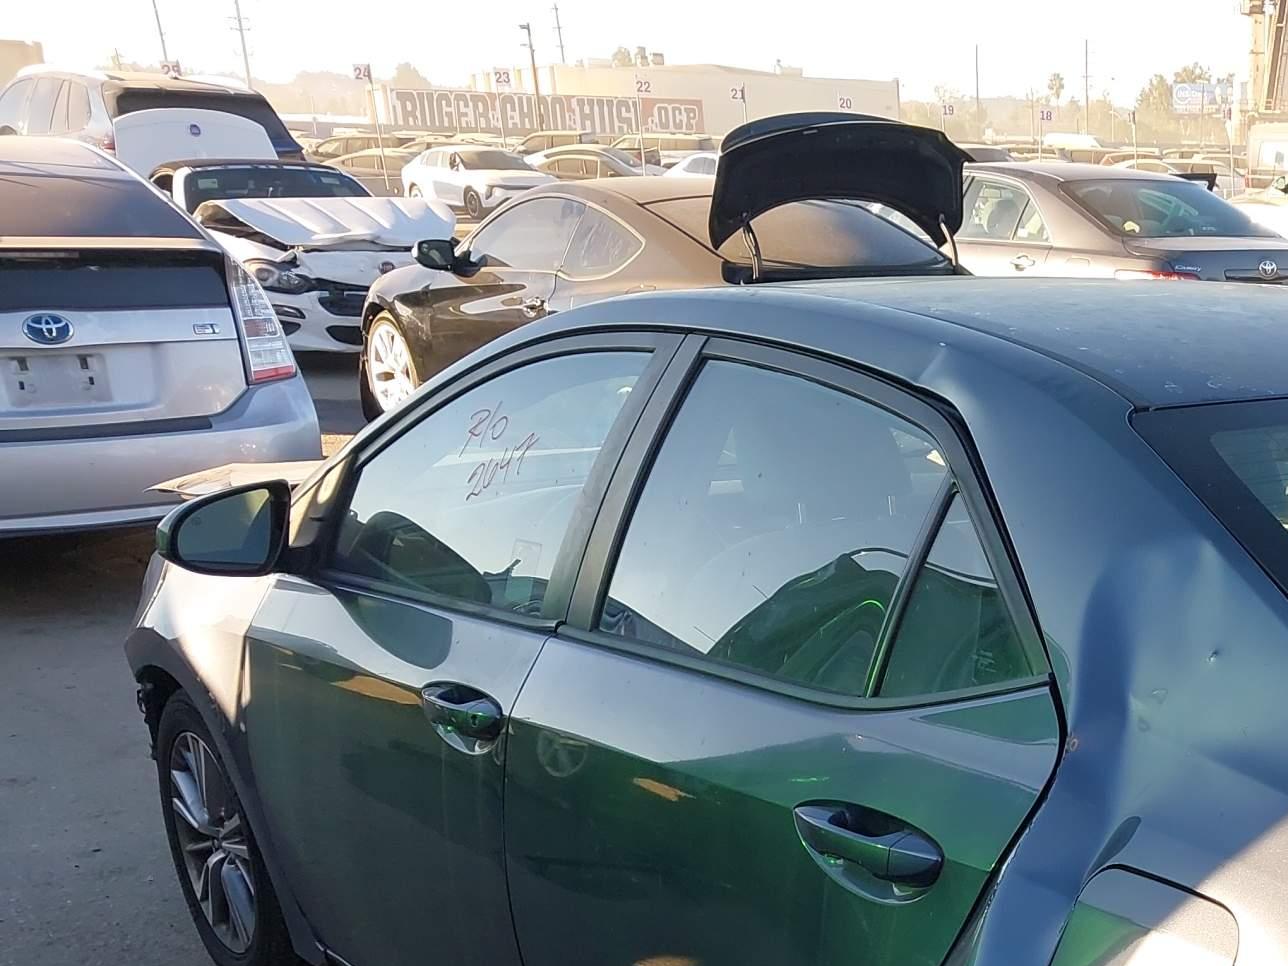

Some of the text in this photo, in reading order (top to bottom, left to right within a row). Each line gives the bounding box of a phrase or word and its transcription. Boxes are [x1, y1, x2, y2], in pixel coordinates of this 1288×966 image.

[354, 67, 371, 80] 24
[495, 71, 511, 84] 23
[636, 81, 651, 93] 22
[731, 88, 745, 100] 21
[839, 97, 852, 109] 20
[943, 105, 954, 116] 19
[1040, 110, 1052, 121] 18
